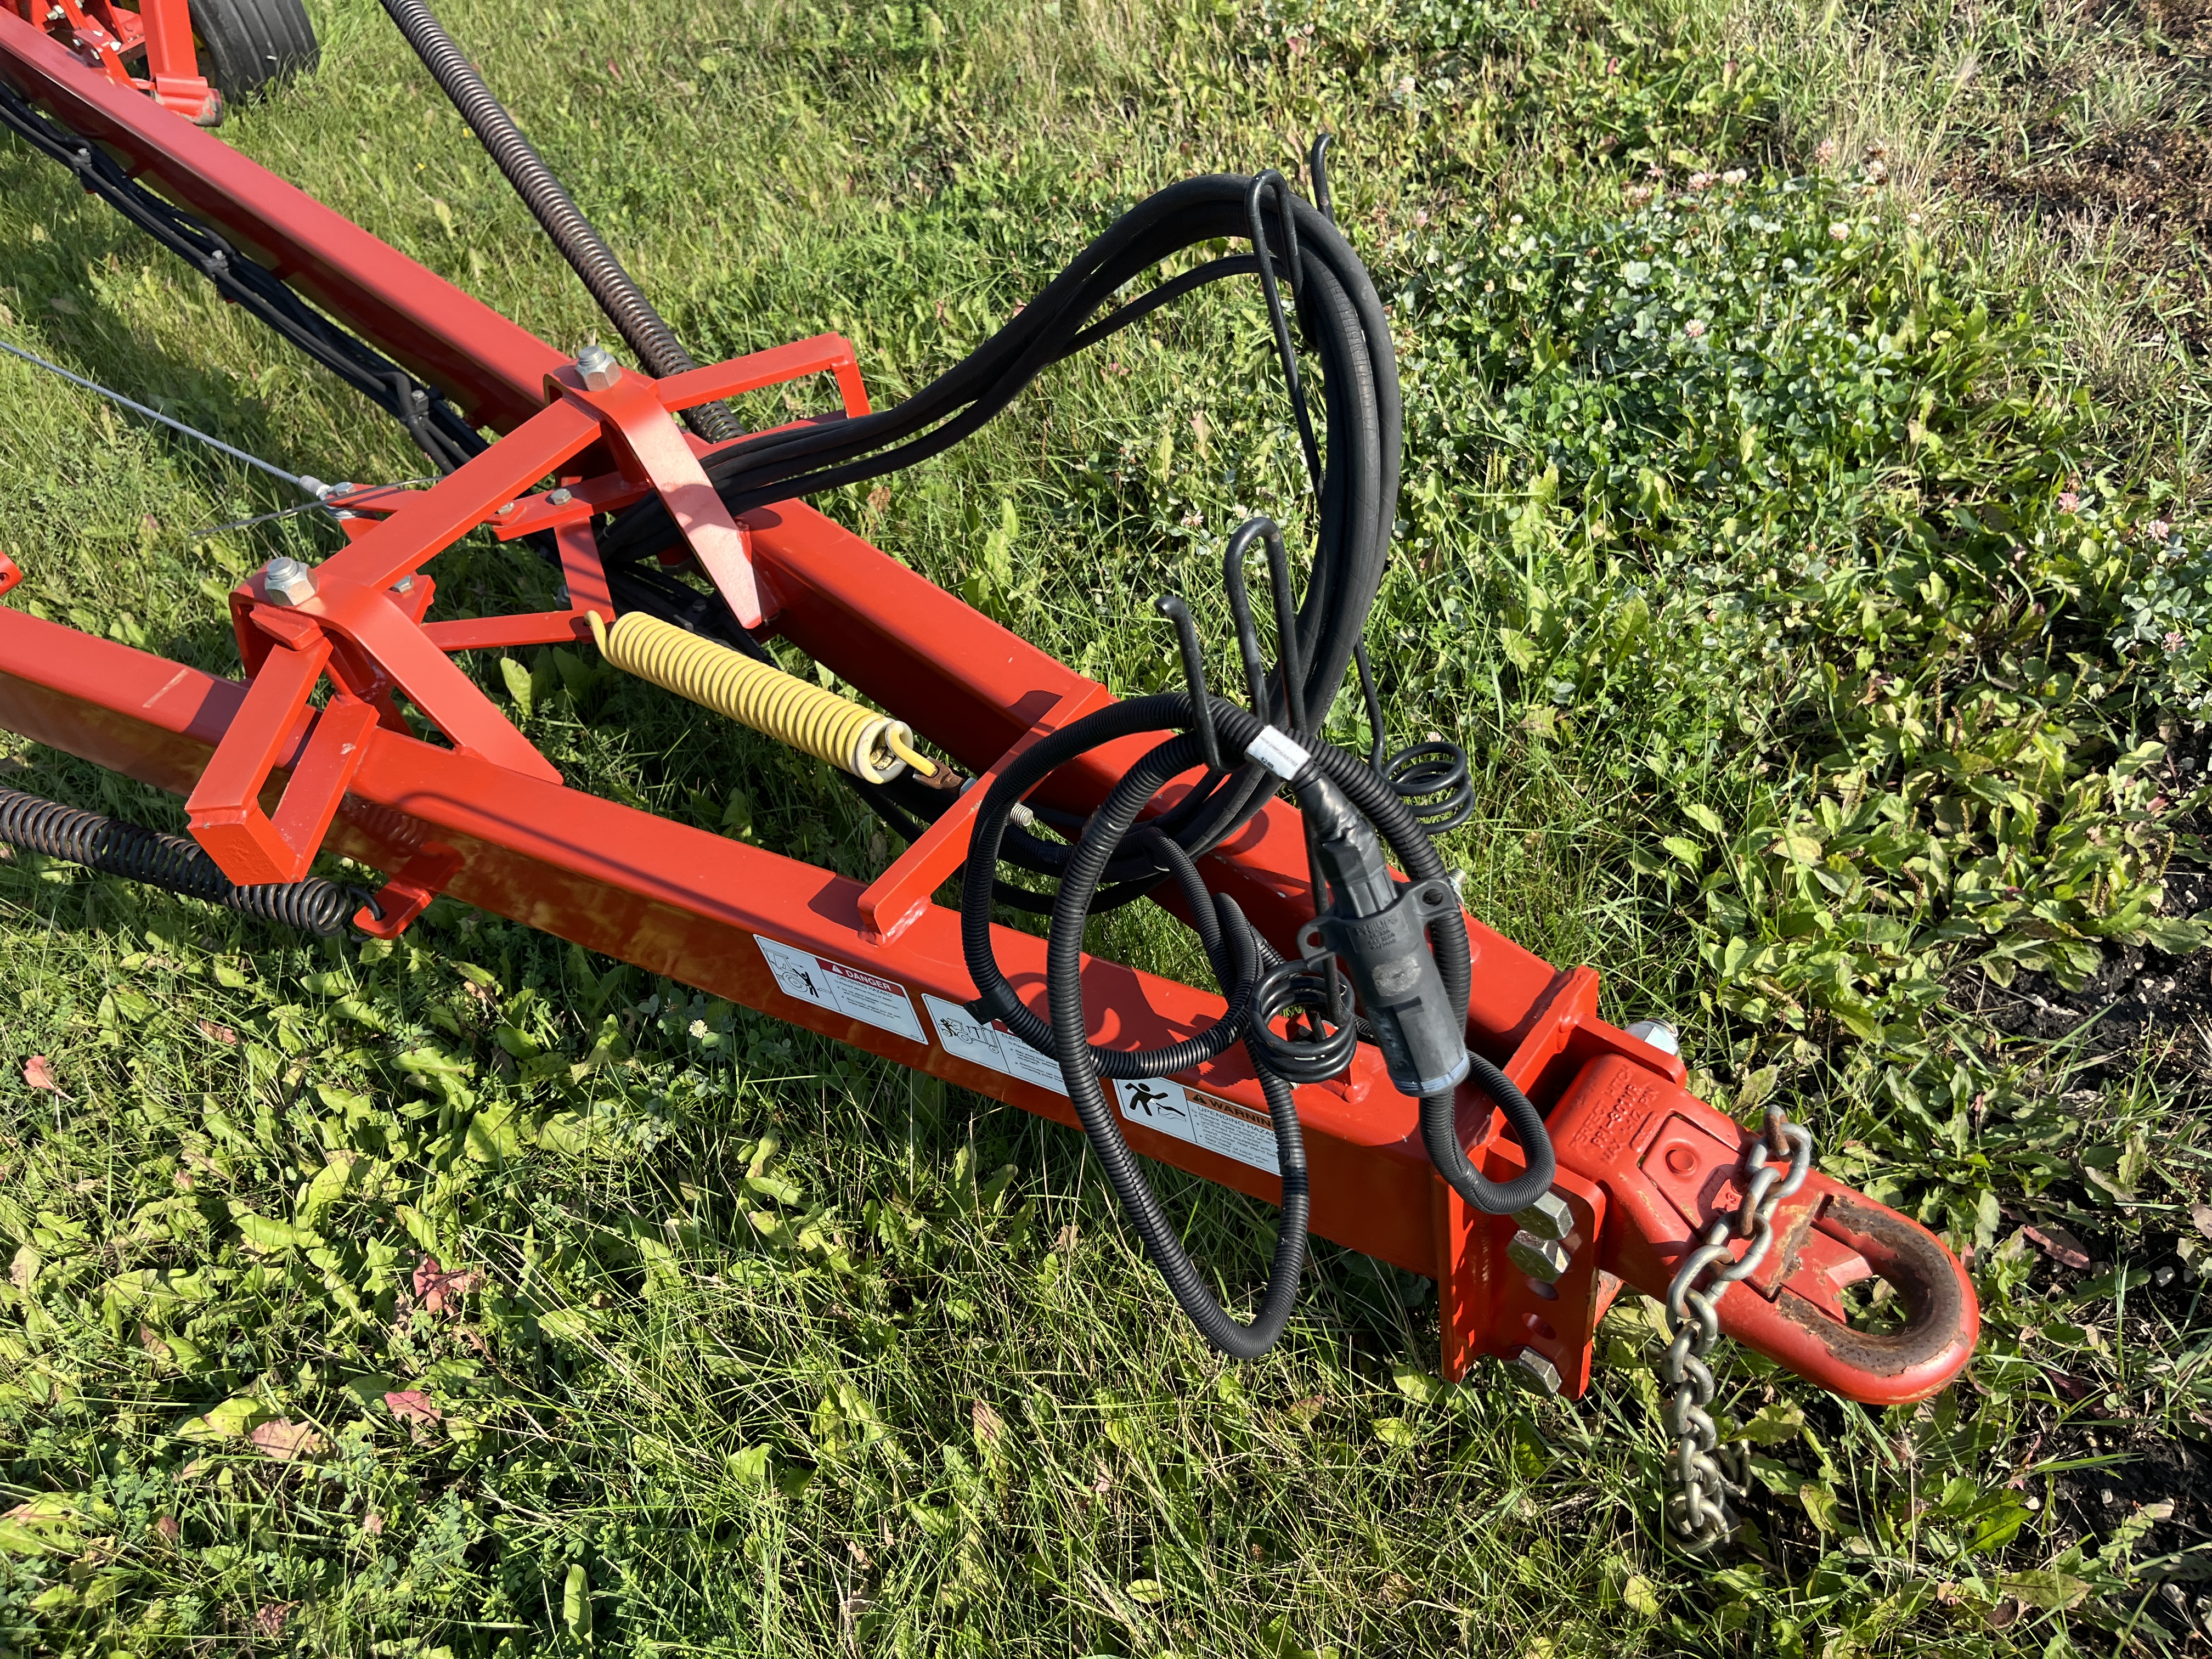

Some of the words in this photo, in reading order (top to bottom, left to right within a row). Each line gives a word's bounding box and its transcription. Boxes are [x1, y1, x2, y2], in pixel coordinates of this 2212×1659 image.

[1354, 915, 1397, 936] PHILIPS
[837, 975, 867, 989] CRUSHING
[868, 986, 892, 997] HAZARD
[845, 970, 890, 990] DANGER
[1198, 1107, 1244, 1126] UPENDING
[1247, 1124, 1276, 1138] HAZAR
[1199, 1112, 1219, 1121] prevent
[1221, 1121, 1241, 1129] serious
[1210, 1100, 1273, 1126] WARNIN
[1200, 1116, 1220, 1125] Tongue
[1237, 1130, 1255, 1138] rapidly
[1201, 1121, 1227, 1132] unhitched
[1212, 1128, 1231, 1137] models
[1233, 1137, 1259, 1147] equipped
[1206, 1141, 1231, 1152] removing
[1232, 1151, 1254, 1160] drawbar
